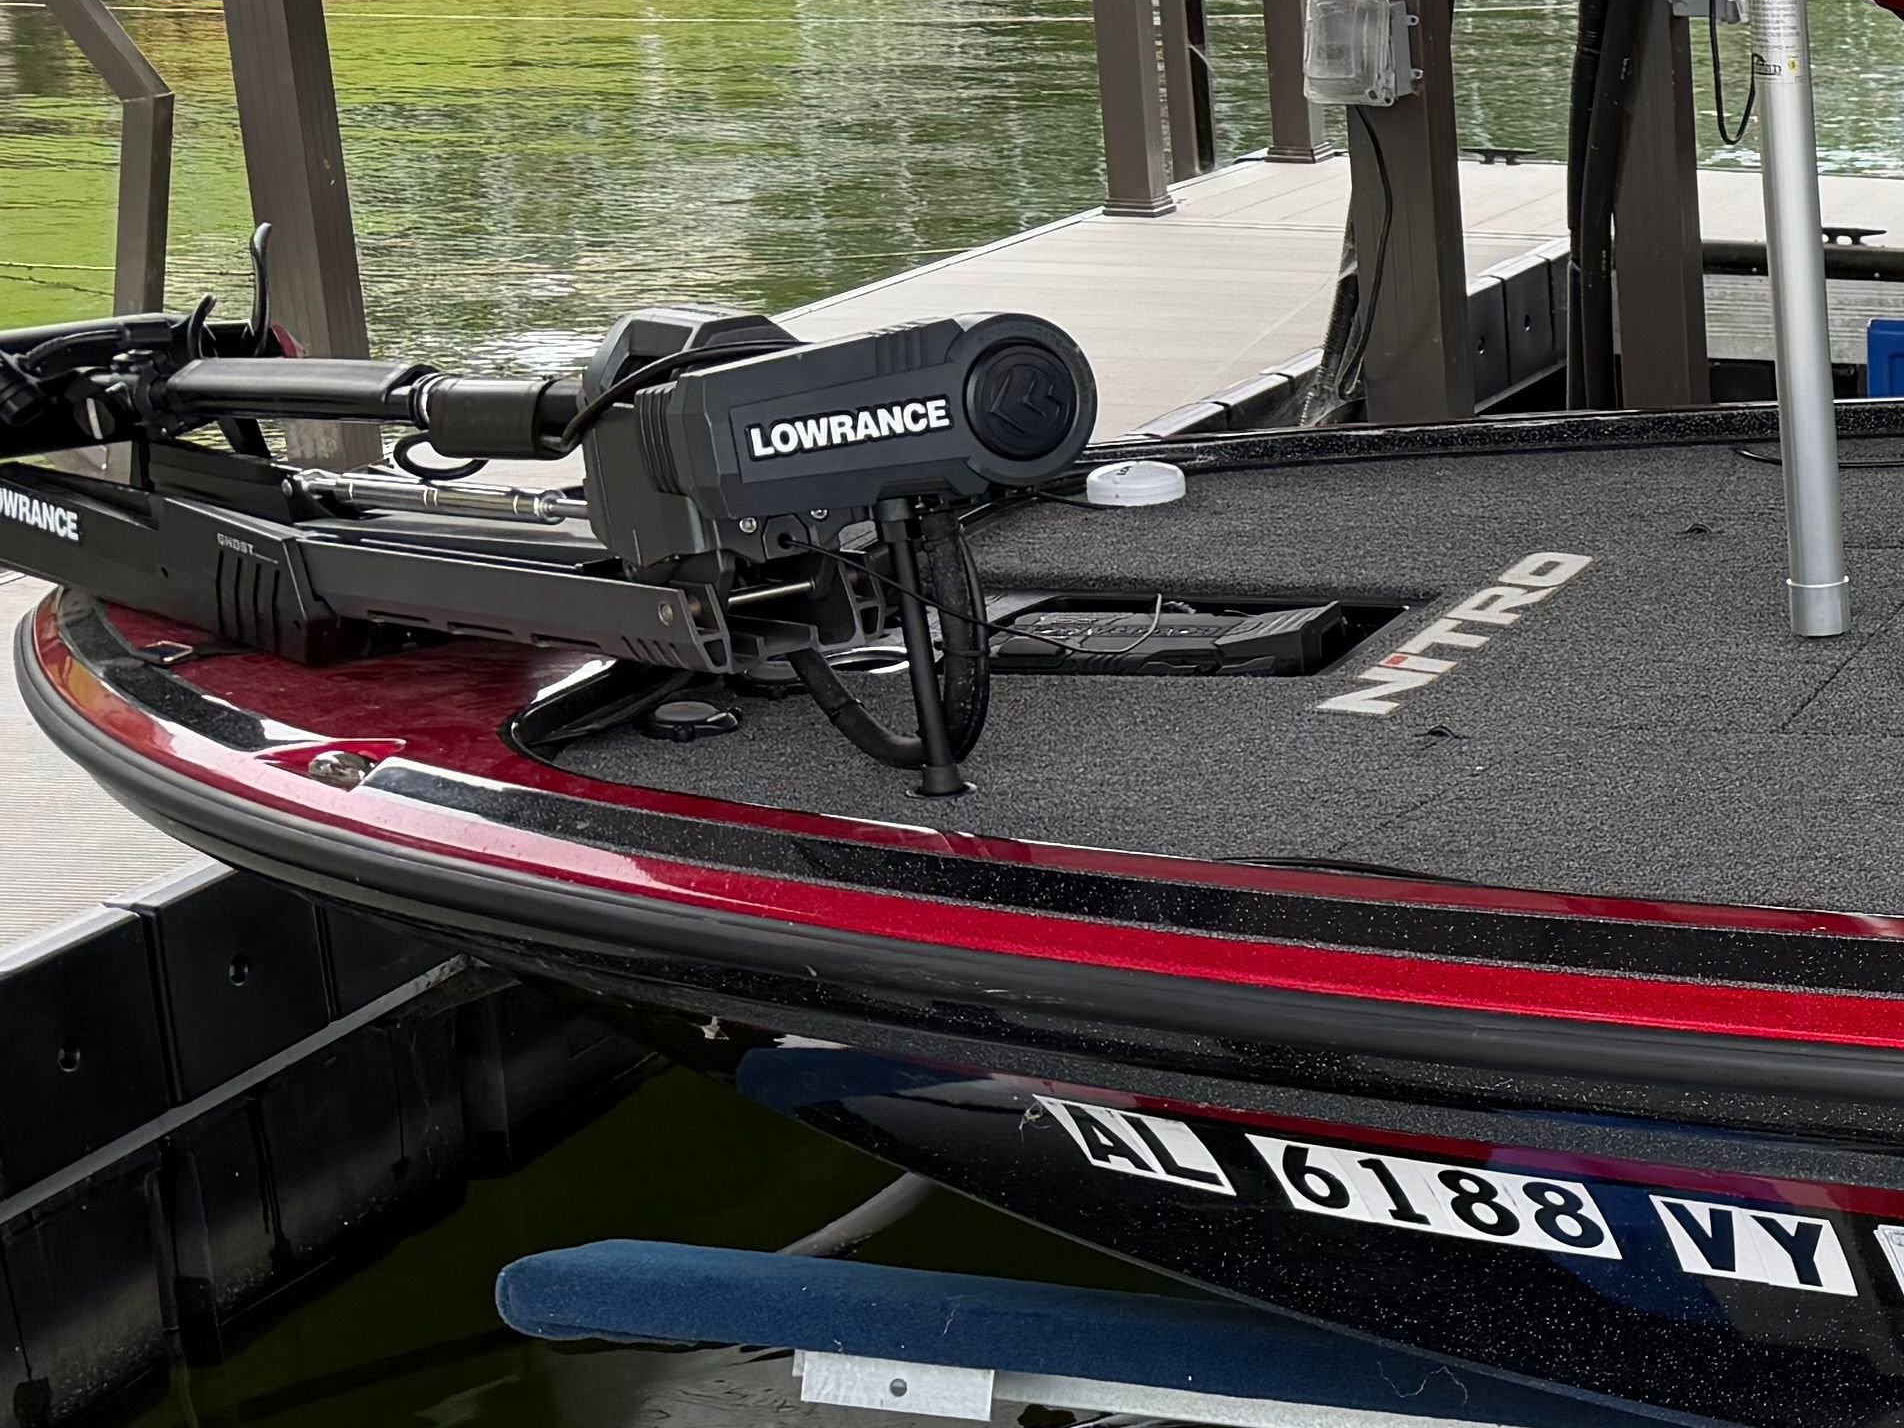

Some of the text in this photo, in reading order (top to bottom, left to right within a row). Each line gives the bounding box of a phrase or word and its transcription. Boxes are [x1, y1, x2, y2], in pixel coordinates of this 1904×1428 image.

[750, 398, 950, 458] LOWRANCE
[216, 532, 255, 556] GHOST
[1064, 1104, 1828, 1287] AL 6188 VY
